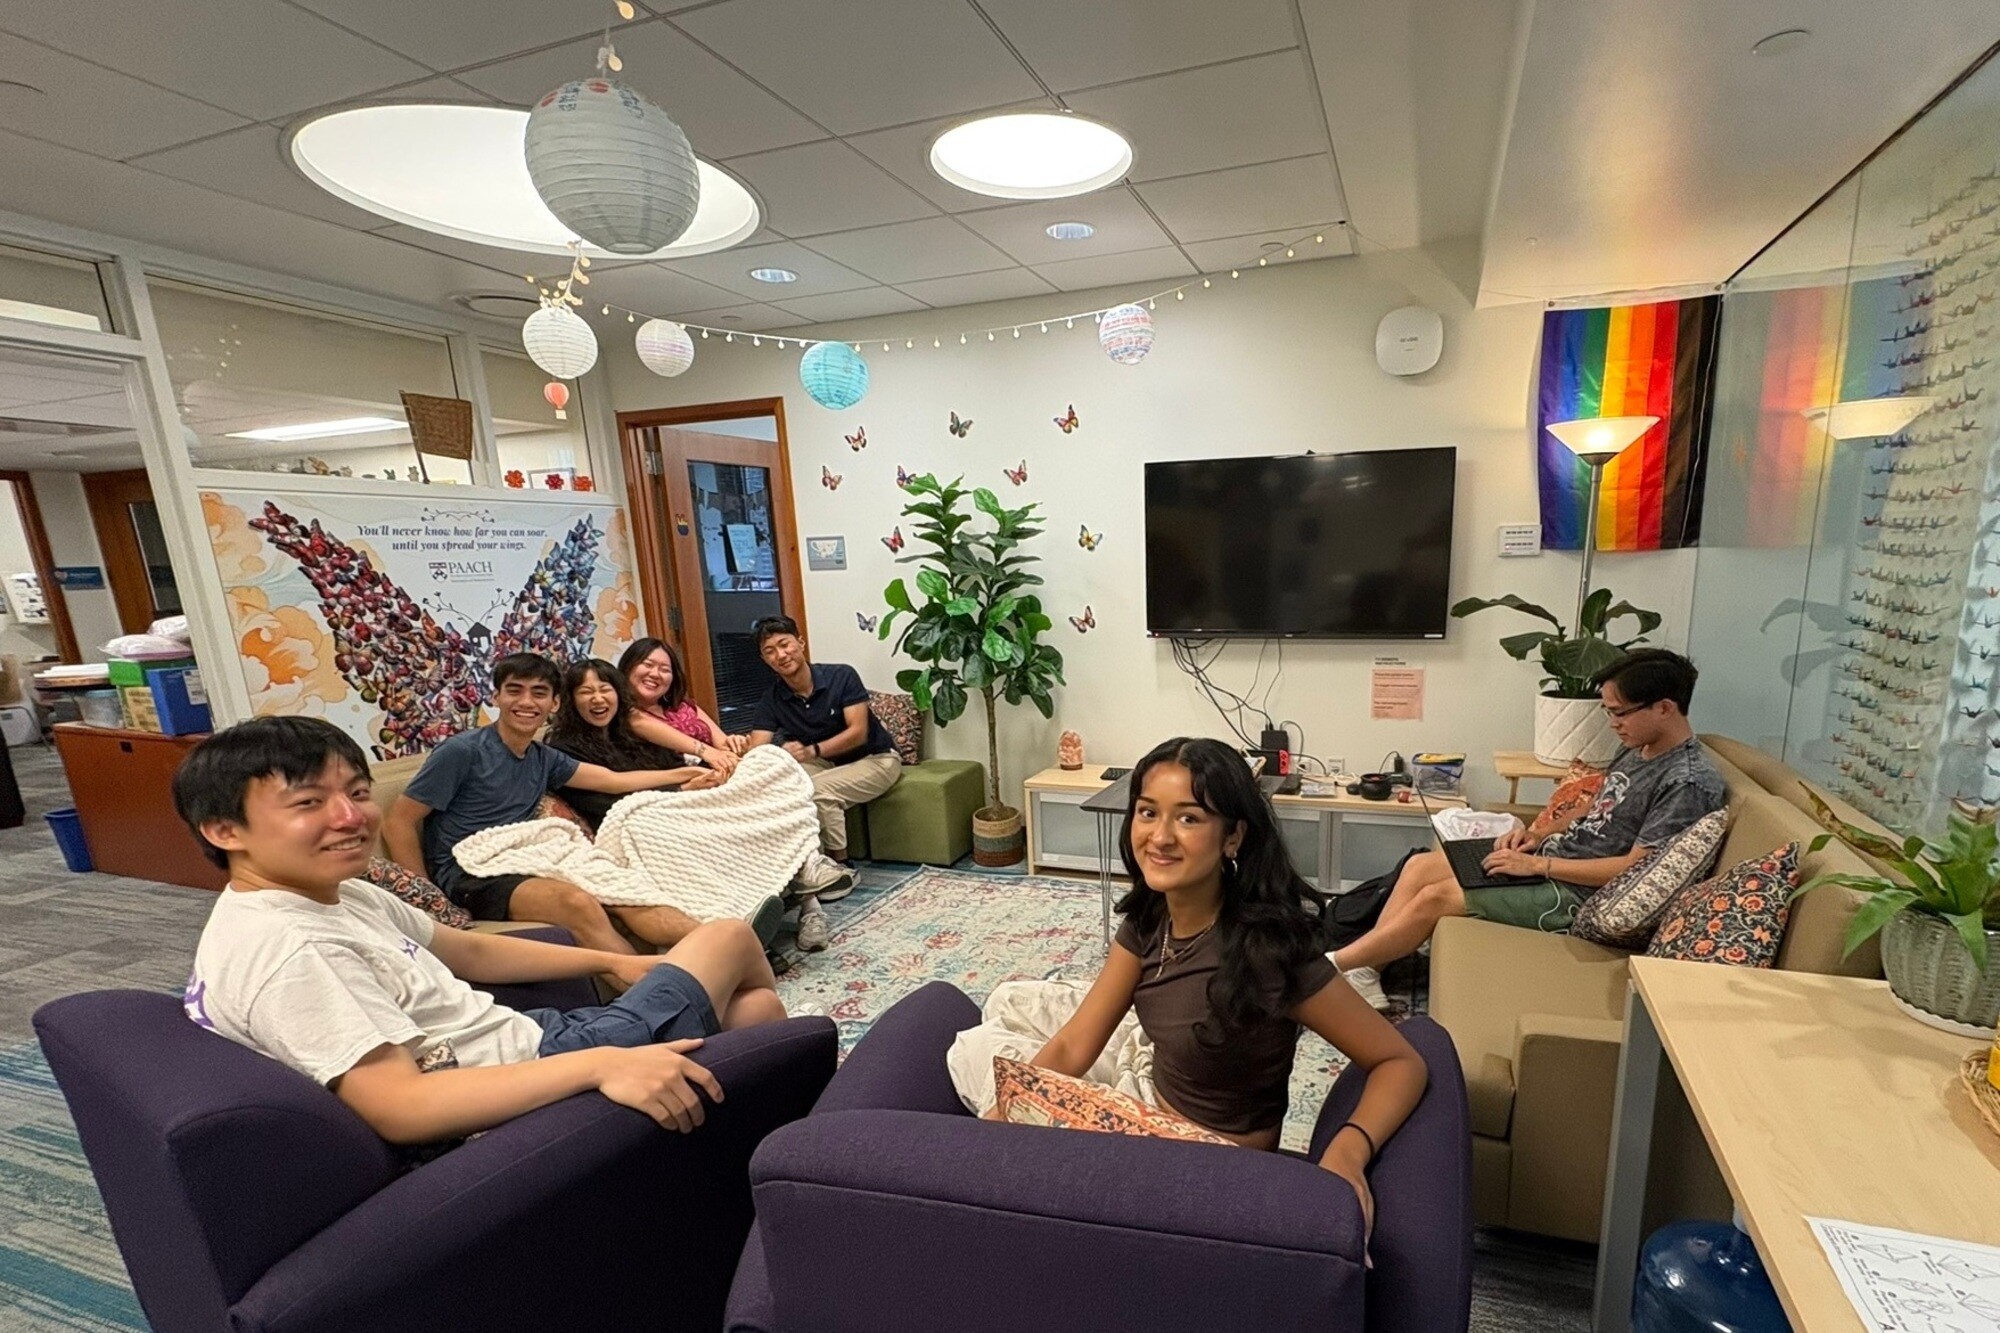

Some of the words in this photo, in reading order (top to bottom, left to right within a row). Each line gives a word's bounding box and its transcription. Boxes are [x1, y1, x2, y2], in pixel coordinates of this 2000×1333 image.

[357, 525, 389, 536] You'll
[392, 528, 422, 536] never
[425, 525, 450, 536] know
[453, 526, 472, 537] how
[475, 526, 488, 538] far
[491, 529, 507, 538] you
[509, 529, 525, 537] can
[392, 540, 418, 550] until
[420, 542, 439, 552] you
[441, 540, 474, 551] spread
[476, 542, 498, 552] your
[448, 561, 493, 574] PAACH
